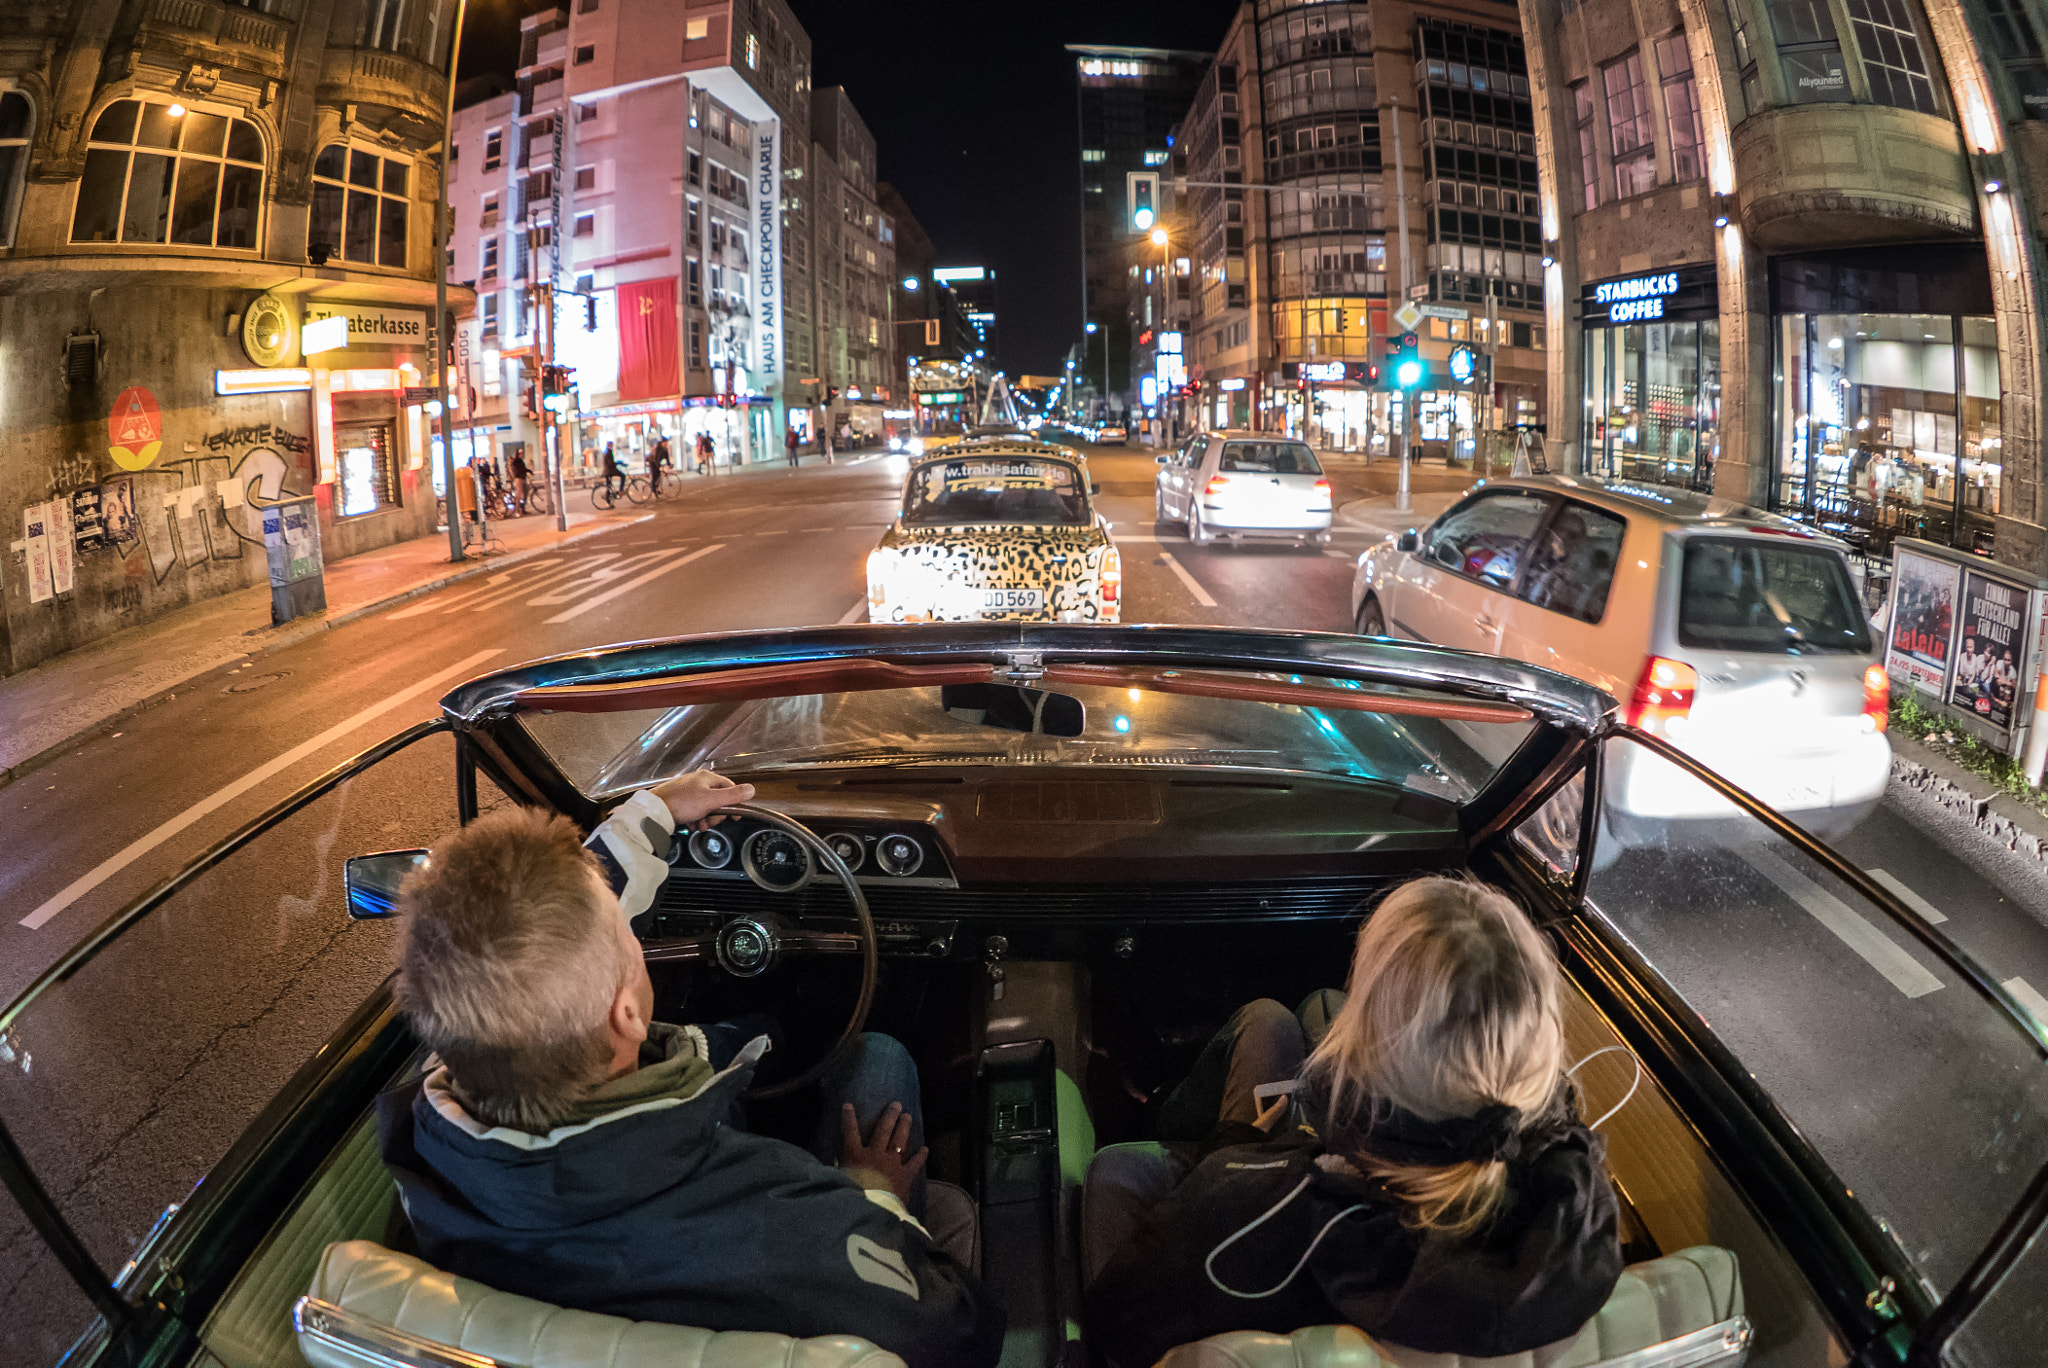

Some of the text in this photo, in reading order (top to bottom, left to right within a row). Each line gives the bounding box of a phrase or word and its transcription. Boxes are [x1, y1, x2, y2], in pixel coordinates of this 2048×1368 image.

[1799, 75, 1844, 88] Allyouneed
[553, 113, 564, 181] CHARLIE
[760, 135, 775, 374] HAUS AM CHECKPOINT CHARLIE
[1596, 273, 1678, 303] STARBUCKS
[1610, 298, 1663, 322] COFFEE
[1007, 592, 1036, 606] 569
[1985, 583, 2011, 607] EINMAL
[1972, 597, 2020, 630] DEUTSCHLAND
[1977, 617, 1992, 638] FÜR
[1990, 623, 2011, 646] ALLE!
[1911, 664, 1943, 683] SEPTEMBER
